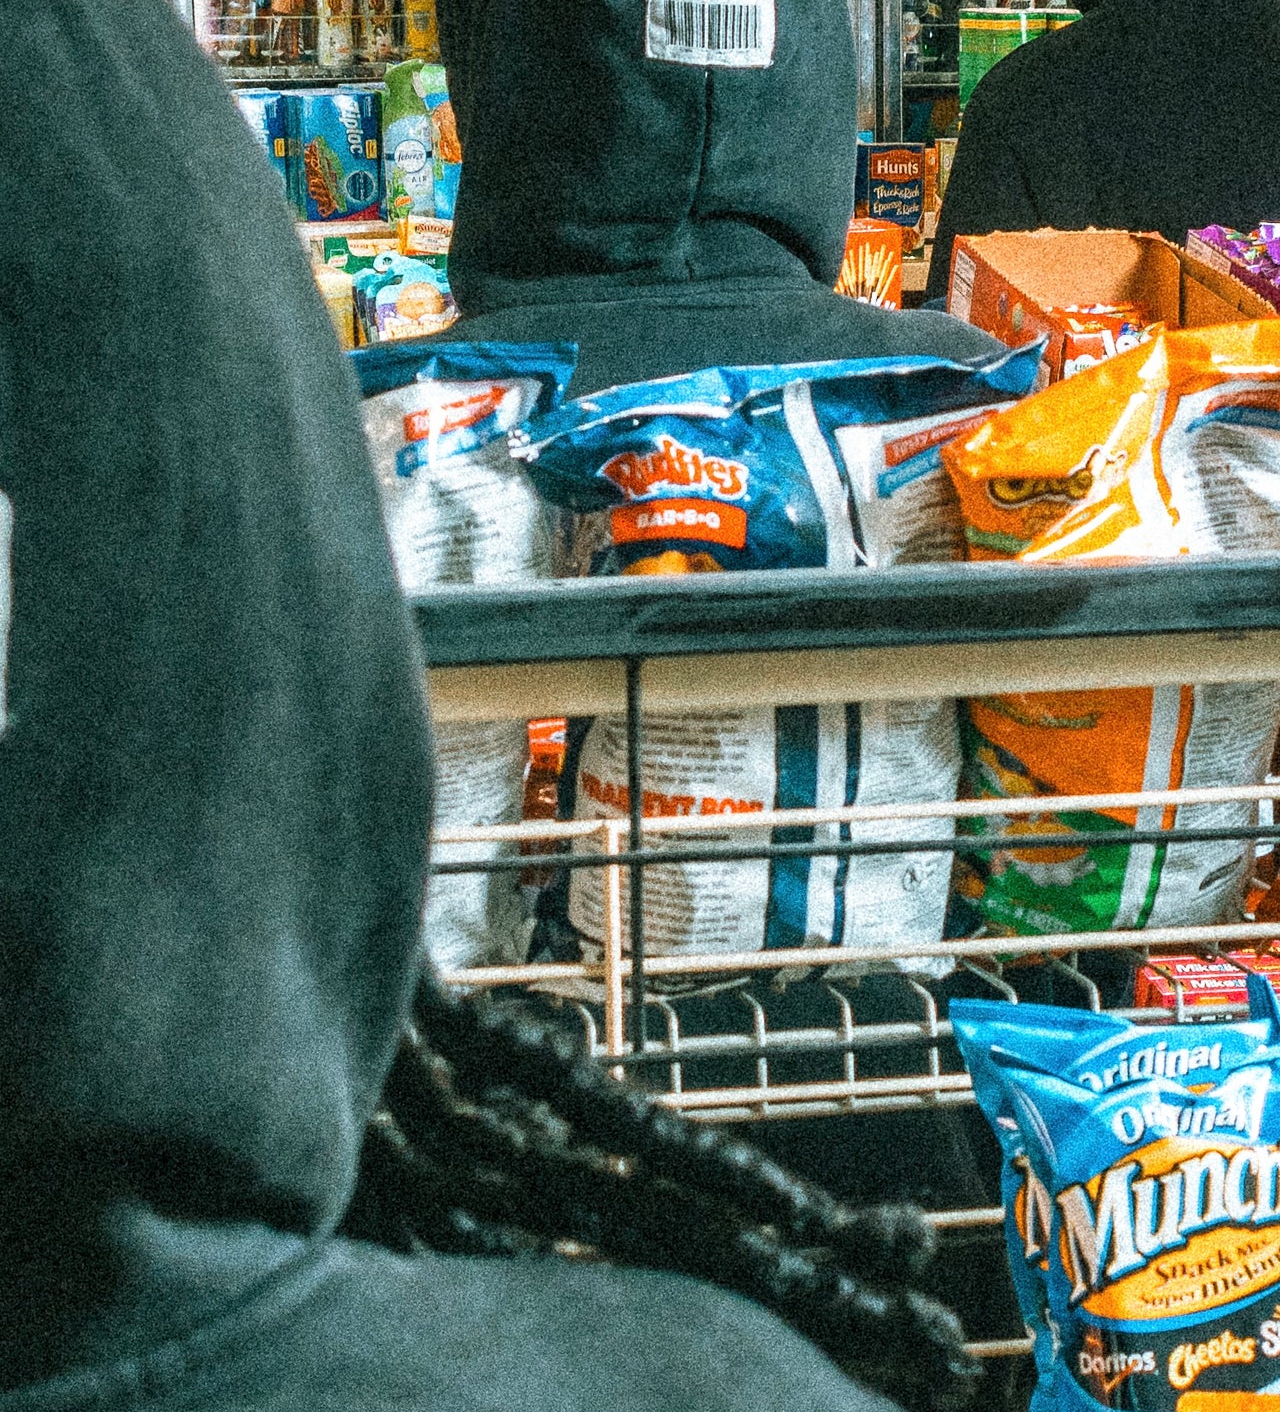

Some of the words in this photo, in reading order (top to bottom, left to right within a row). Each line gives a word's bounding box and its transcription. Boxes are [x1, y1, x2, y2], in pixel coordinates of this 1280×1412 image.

[598, 437, 747, 498] Ruffles
[1154, 1248, 1234, 1283] Snack
[1078, 1350, 1157, 1377] Doritos
[1167, 1329, 1258, 1390] Cheetos
